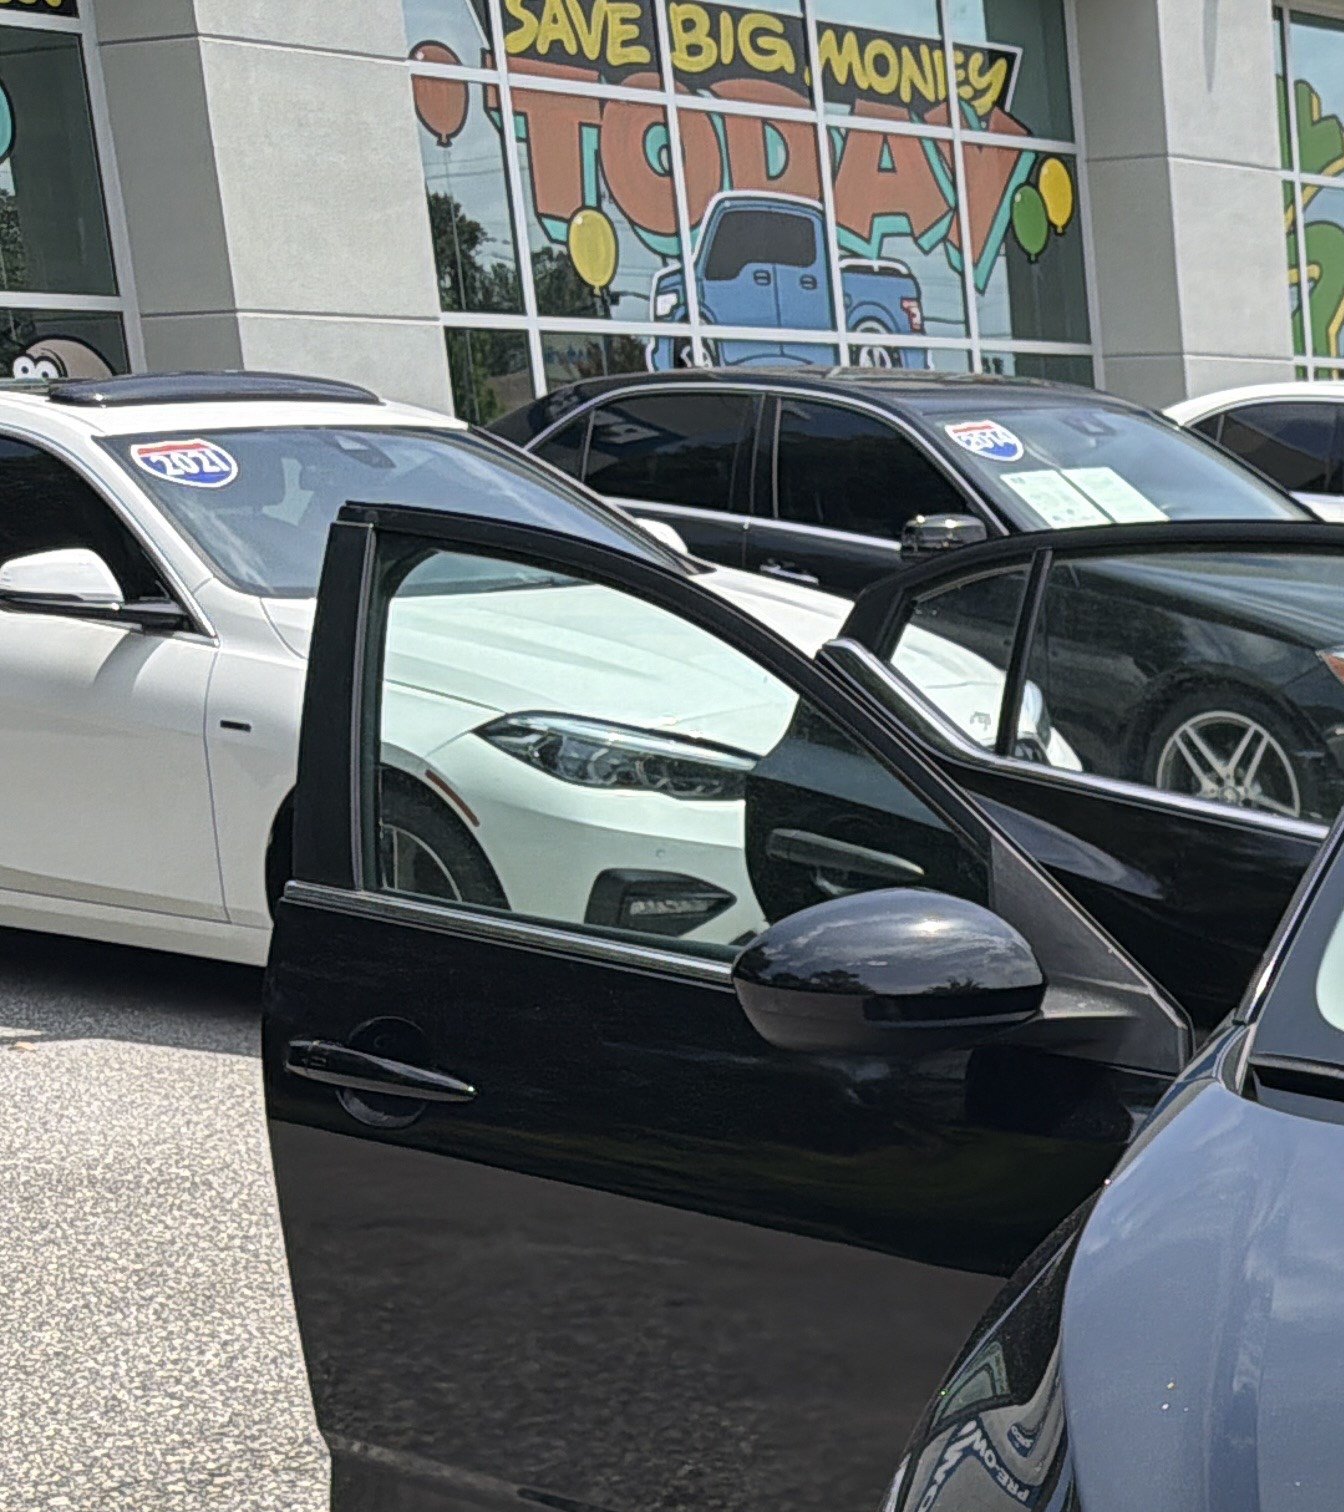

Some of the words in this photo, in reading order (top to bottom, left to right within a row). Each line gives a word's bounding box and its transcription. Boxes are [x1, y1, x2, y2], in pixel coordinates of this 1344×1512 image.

[504, 0, 650, 66] SAVE
[670, 3, 796, 73] BIG
[804, 29, 1007, 117] MONEY
[484, 56, 1033, 275] TODAY
[149, 449, 231, 476] 2021
